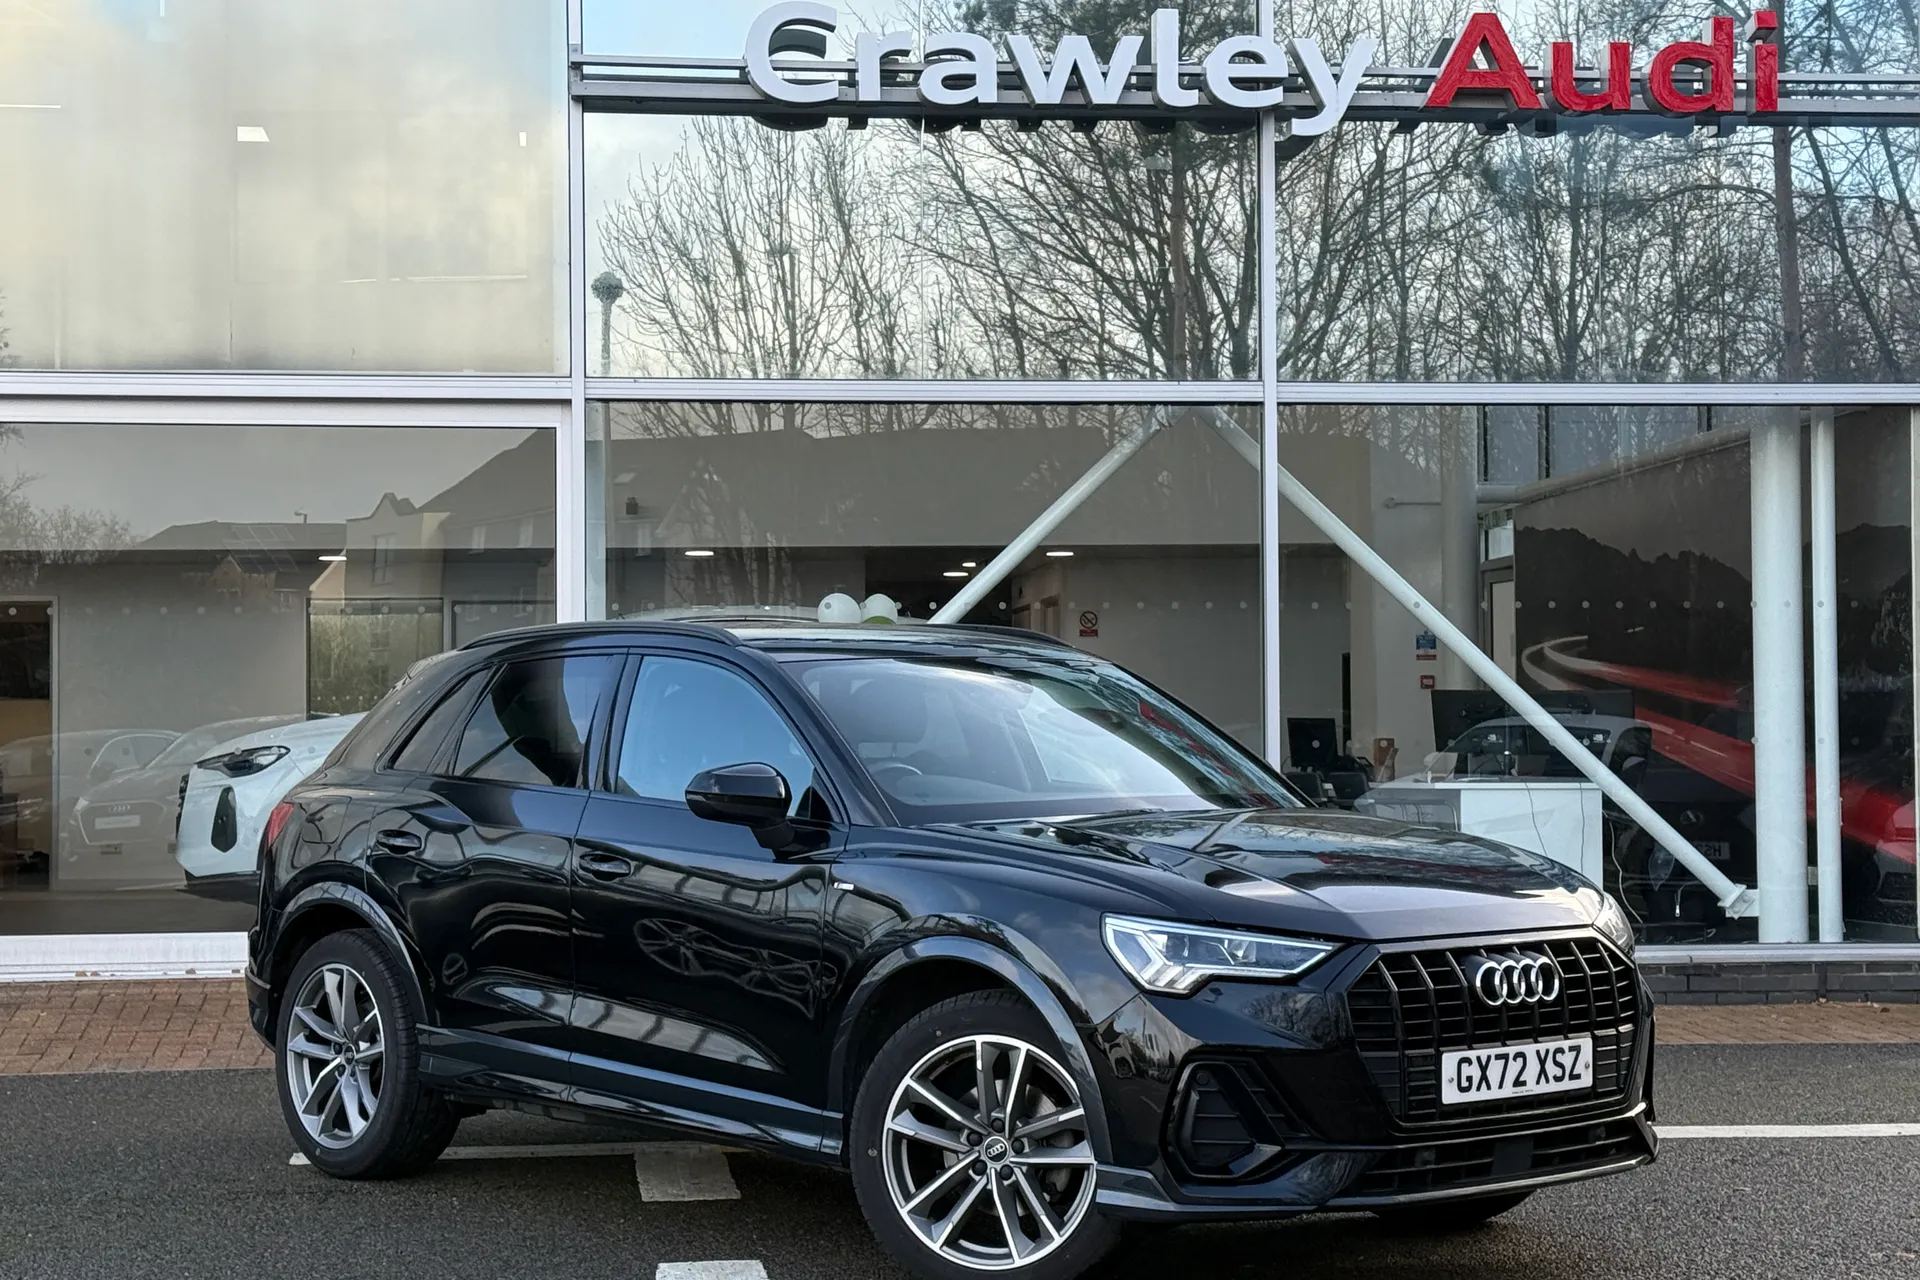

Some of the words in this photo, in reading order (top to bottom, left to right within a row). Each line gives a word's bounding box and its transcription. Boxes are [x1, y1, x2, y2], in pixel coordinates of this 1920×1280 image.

[745, 1, 1379, 136] Crawley
[1424, 11, 1779, 113] Audi
[1456, 1051, 1528, 1093] GX72
[1535, 1044, 1582, 1086] XSZ
